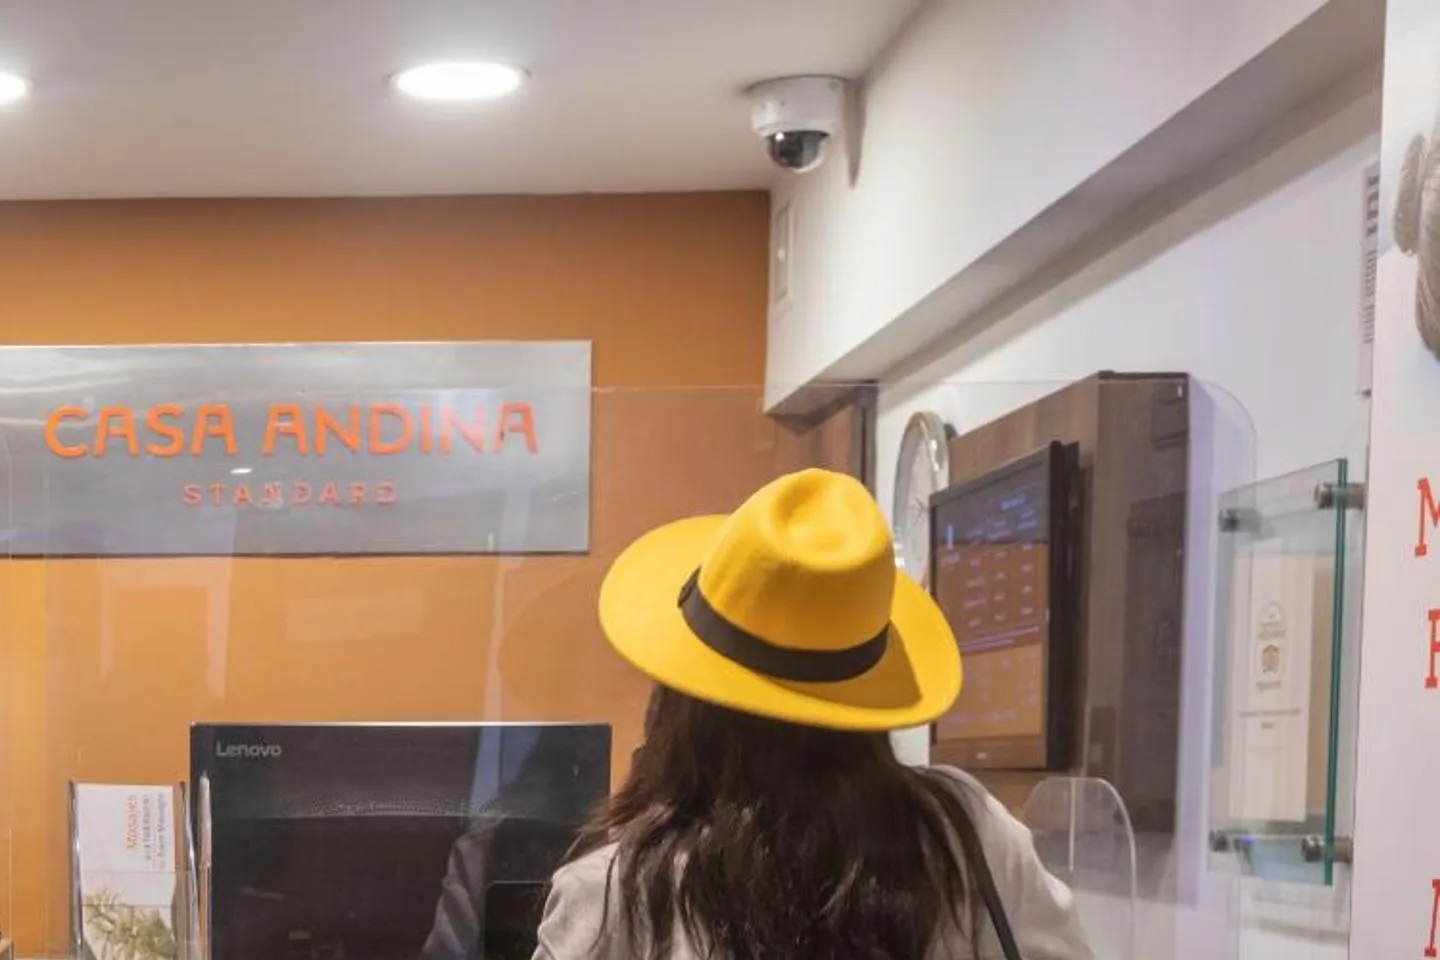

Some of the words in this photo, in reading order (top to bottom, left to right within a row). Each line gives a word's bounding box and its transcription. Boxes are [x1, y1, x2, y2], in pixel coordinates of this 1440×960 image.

[44, 403, 238, 458] CASA
[262, 402, 538, 457] ANDINA
[183, 480, 398, 508] STANDARD
[216, 739, 282, 757] Lenovo
